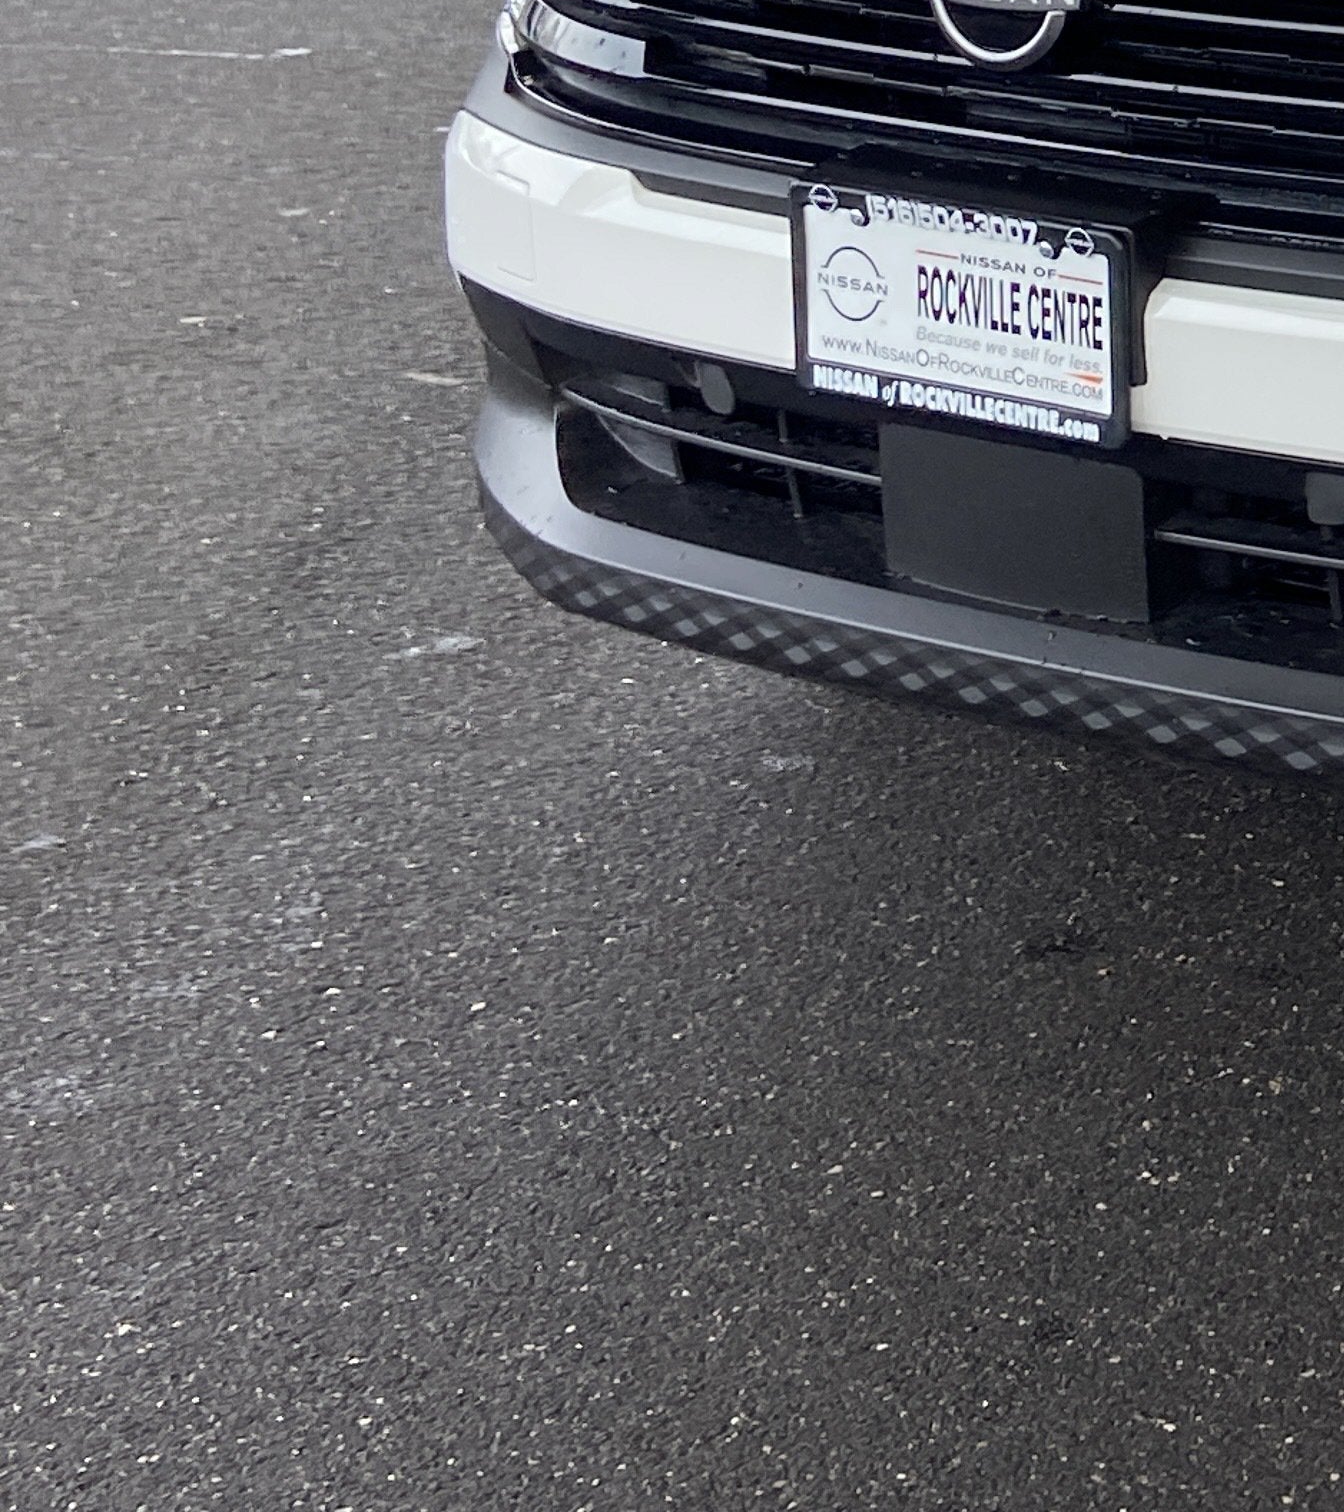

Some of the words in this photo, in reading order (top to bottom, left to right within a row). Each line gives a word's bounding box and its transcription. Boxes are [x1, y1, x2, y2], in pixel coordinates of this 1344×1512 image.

[816, 272, 889, 296] NISSAN
[960, 253, 1027, 275] NISSAN
[1033, 265, 1058, 279] OF
[916, 264, 1022, 336] ROCKVILLE
[1027, 283, 1104, 350] CENTRE
[916, 326, 982, 351] Because
[985, 340, 1009, 357] we
[1011, 346, 1041, 364] sell
[1043, 350, 1066, 369] for
[813, 364, 880, 399] NISSAN
[881, 382, 899, 407] of
